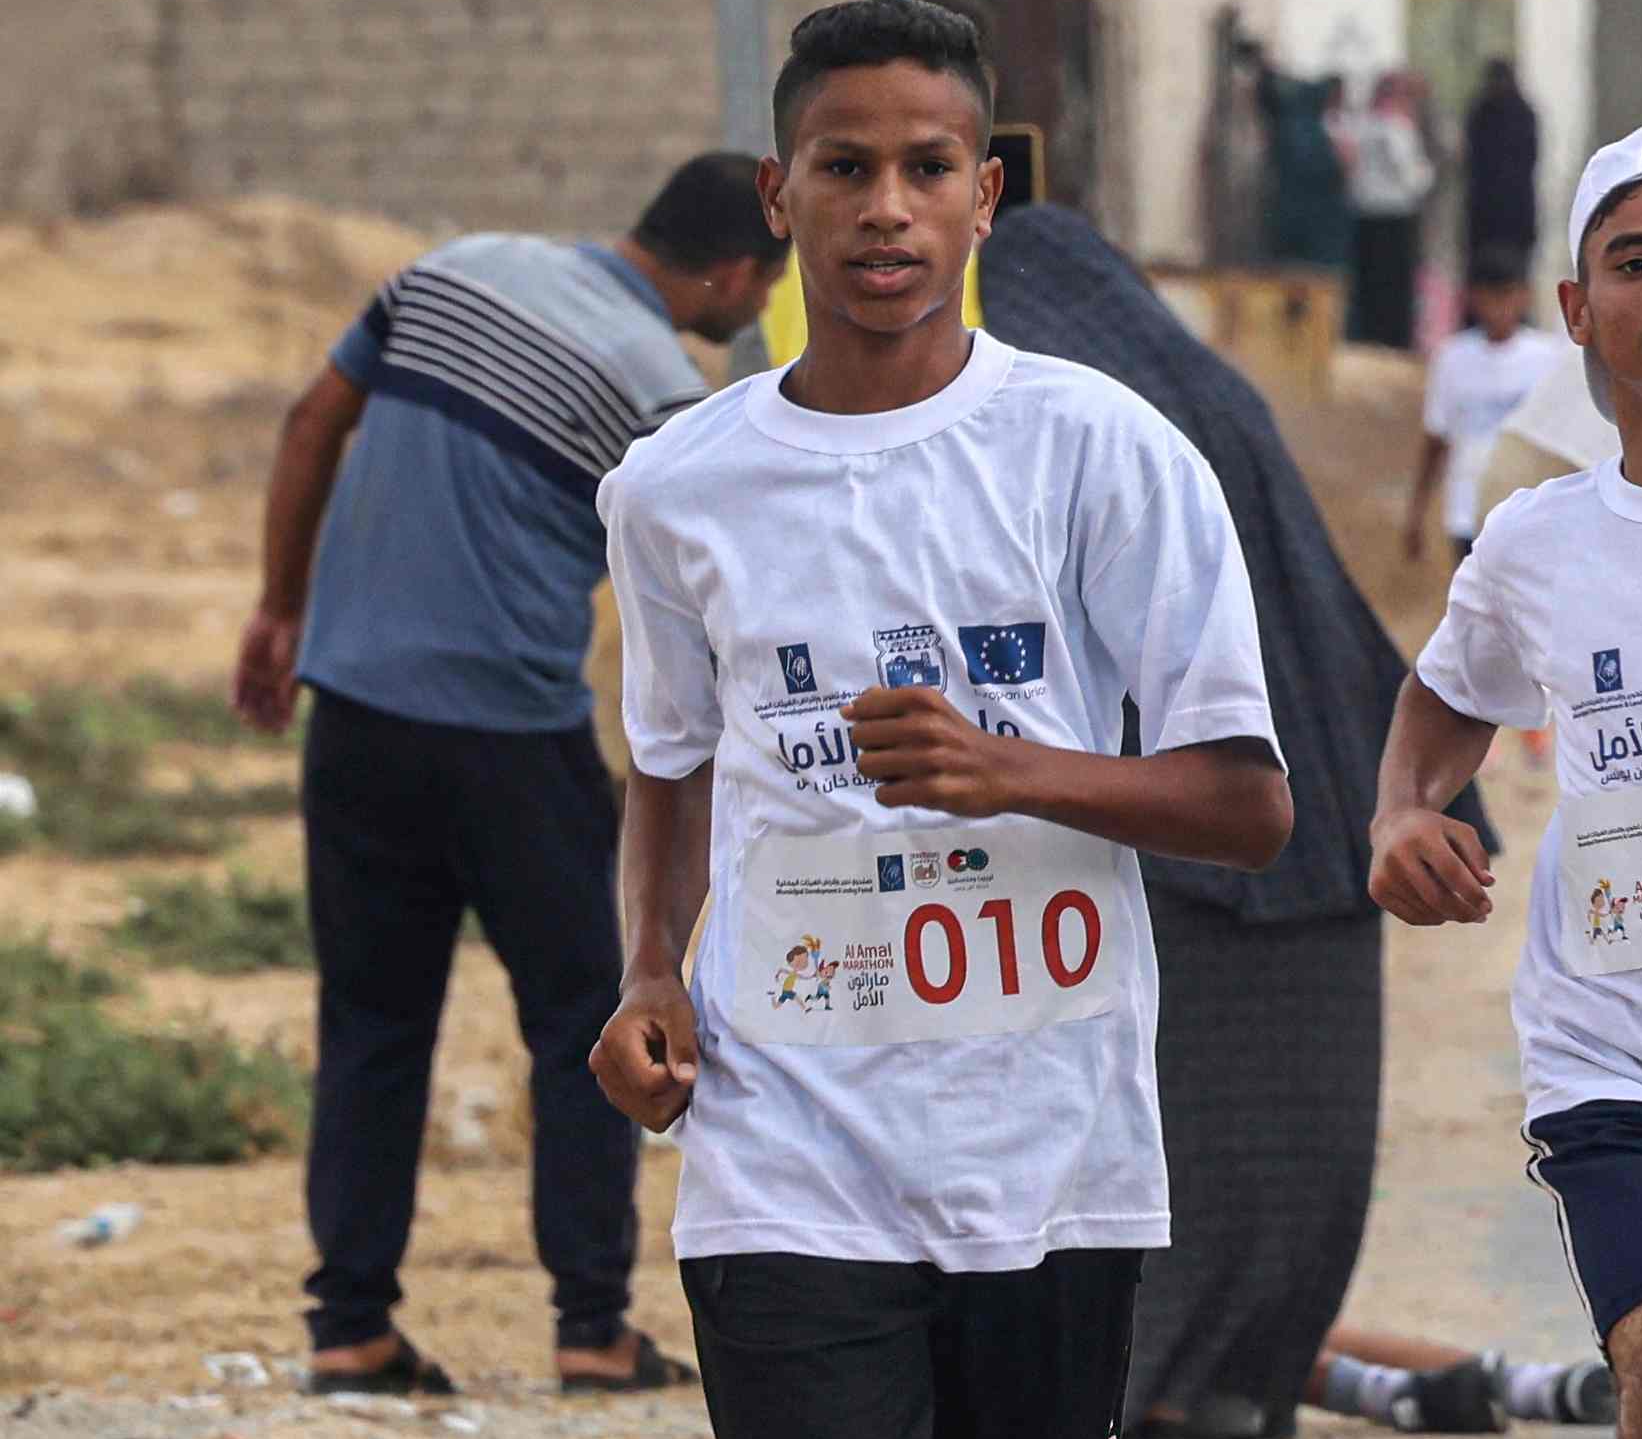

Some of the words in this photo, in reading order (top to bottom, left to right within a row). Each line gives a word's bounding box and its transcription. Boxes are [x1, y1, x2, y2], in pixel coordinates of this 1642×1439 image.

[845, 945, 856, 958] Al
[857, 943, 892, 958] Amal
[904, 890, 1101, 1005] 010
[843, 958, 894, 971] MARATHON
[848, 972, 889, 992] ماراثون
